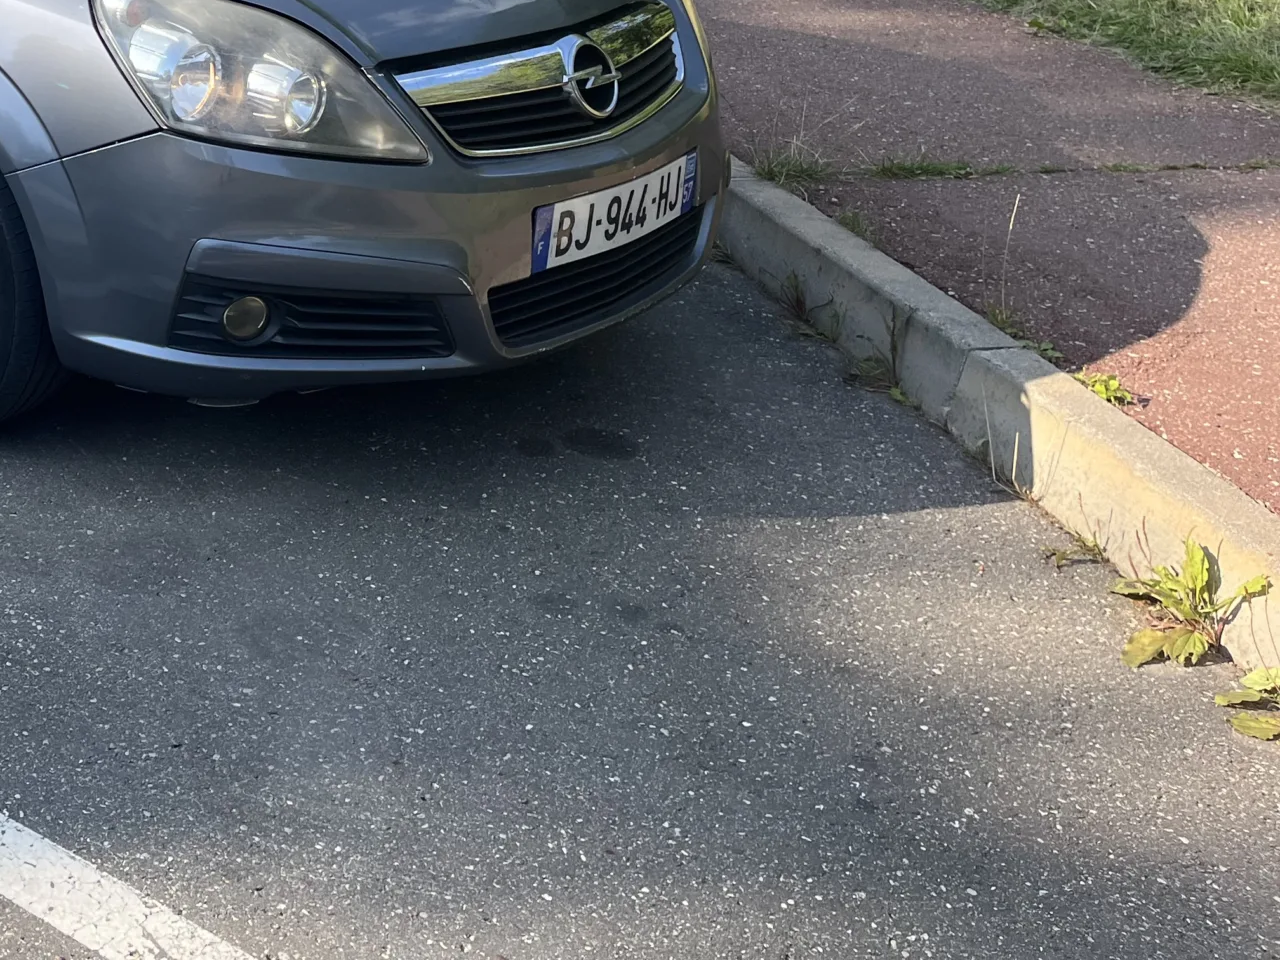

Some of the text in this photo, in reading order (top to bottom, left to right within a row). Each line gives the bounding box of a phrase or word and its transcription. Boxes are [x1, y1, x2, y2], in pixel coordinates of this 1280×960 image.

[682, 180, 694, 204] 57
[554, 165, 682, 258] BJ-944-HJ
[536, 241, 545, 255] F
